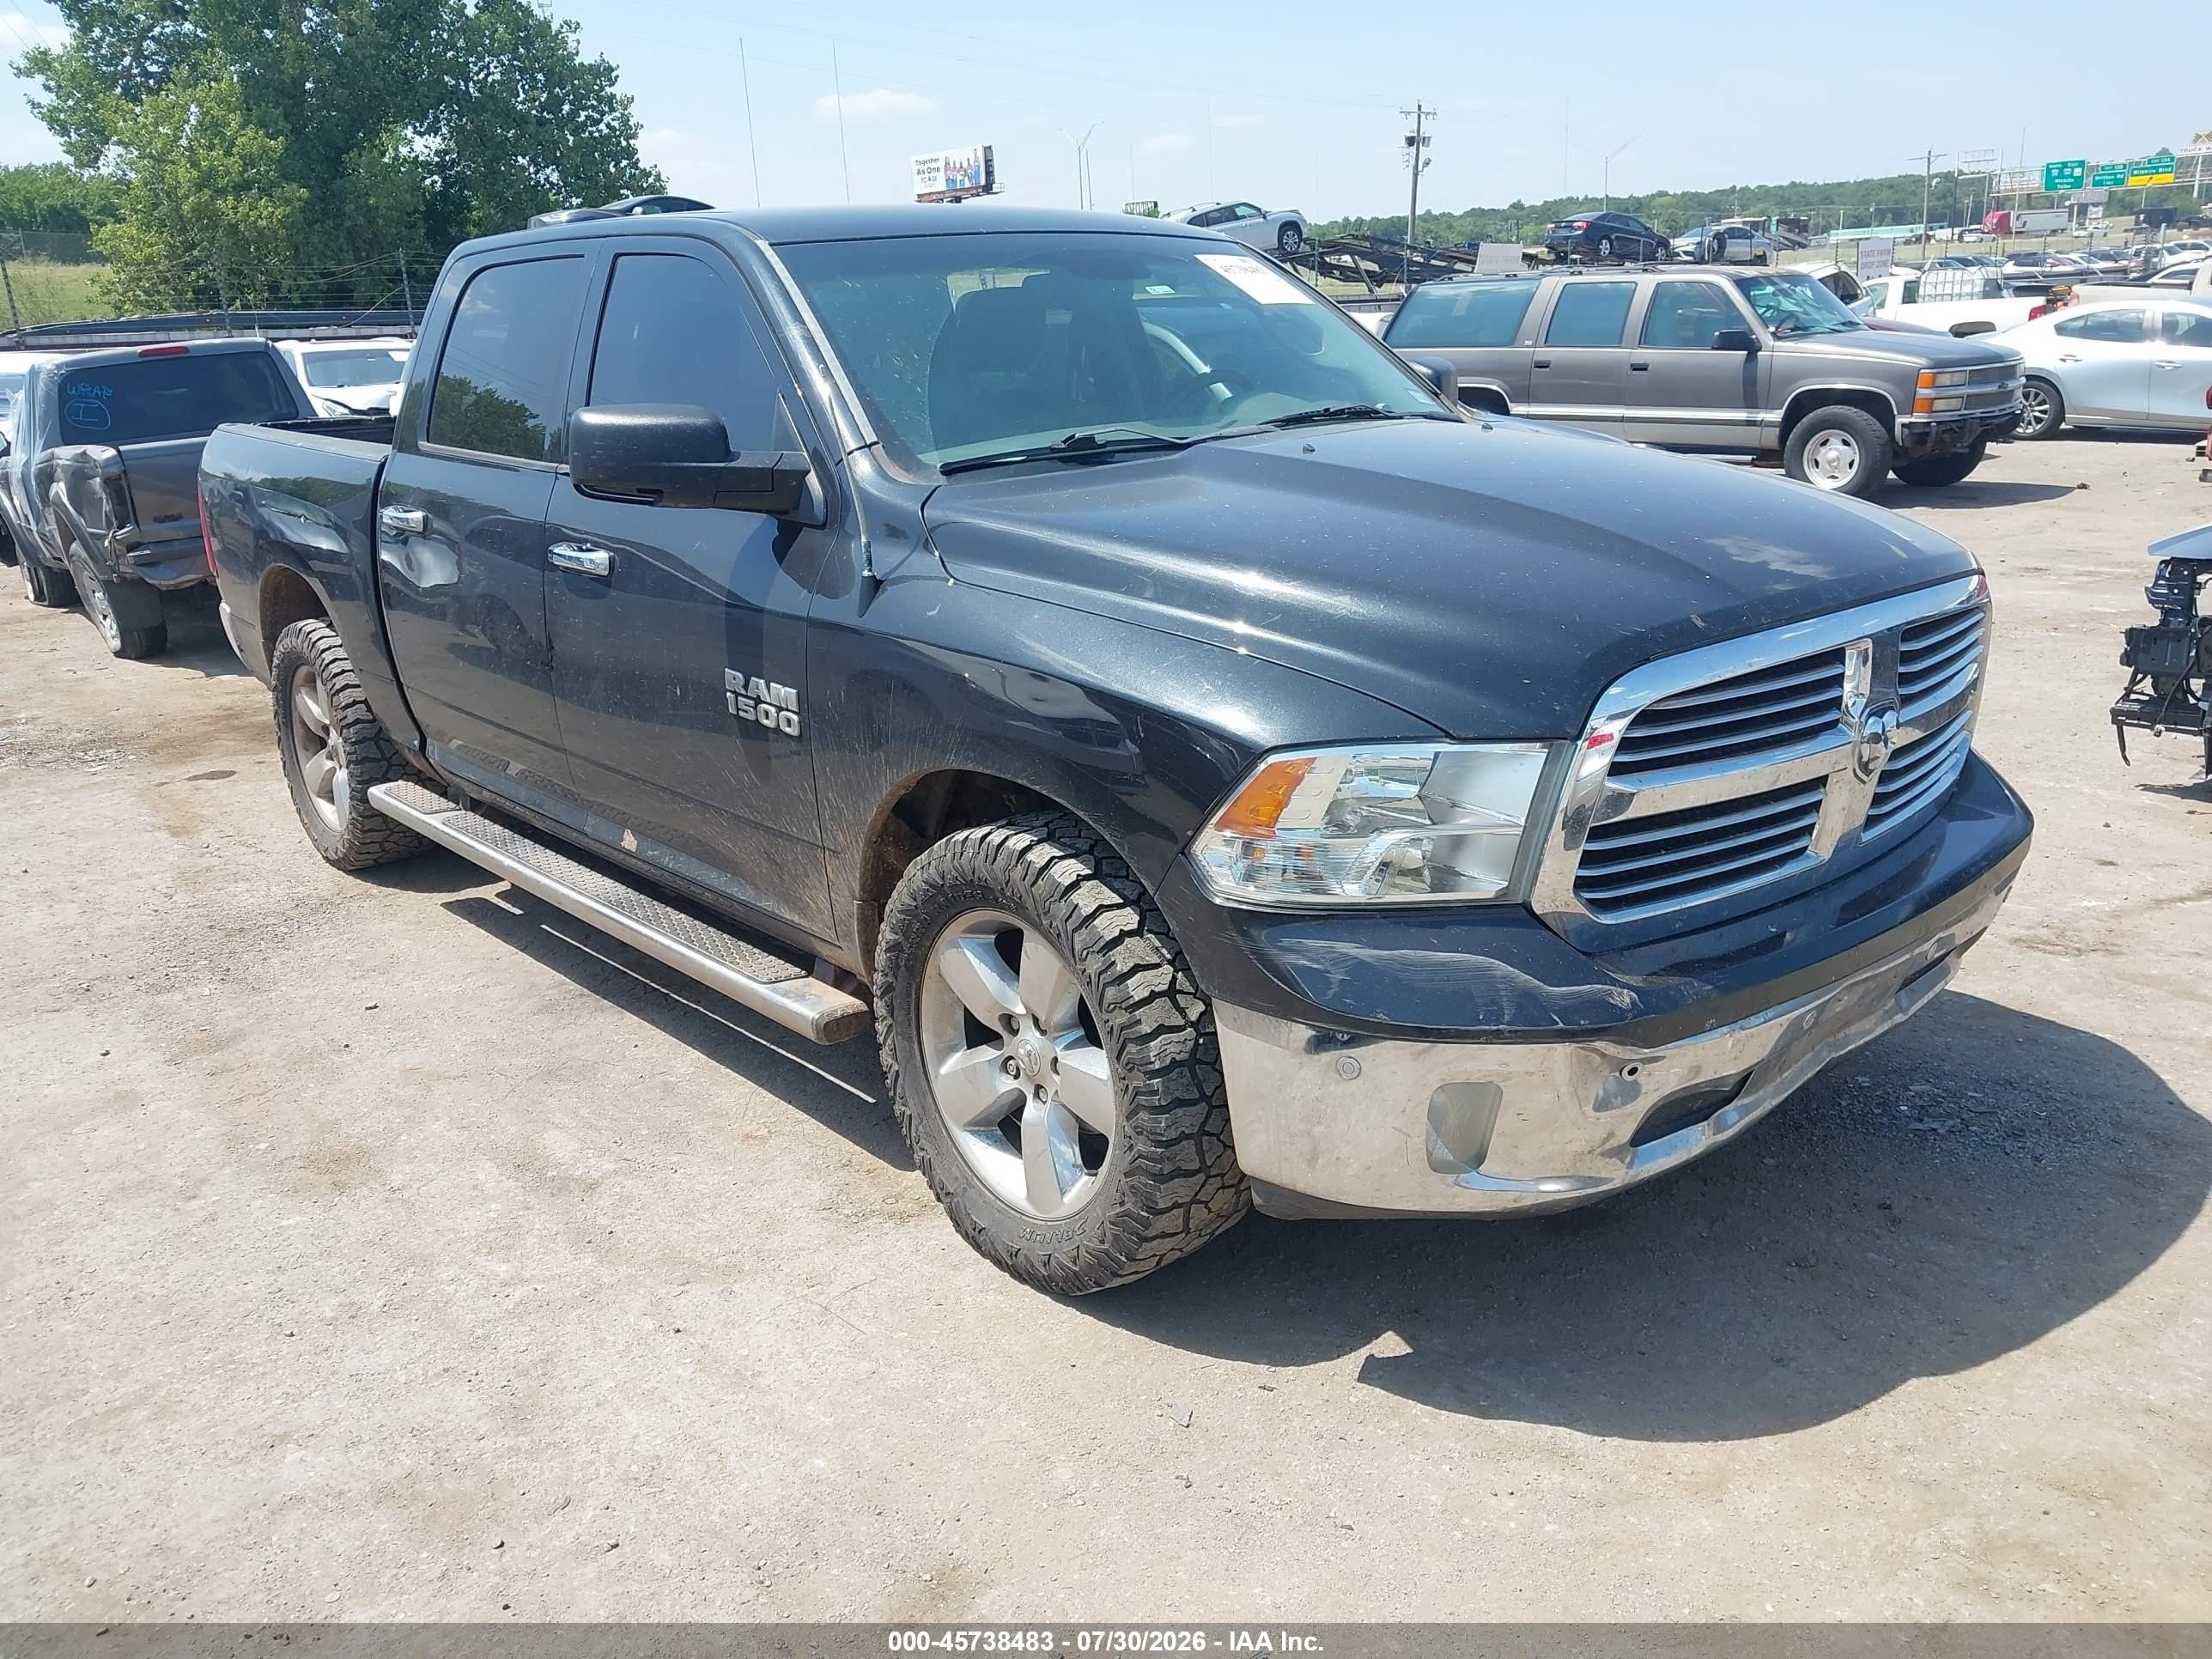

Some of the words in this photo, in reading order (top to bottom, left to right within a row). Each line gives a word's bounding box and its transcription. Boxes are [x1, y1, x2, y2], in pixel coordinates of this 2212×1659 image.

[915, 157, 940, 166] Together
[1860, 249, 1876, 258] STATE
[725, 667, 799, 713] RAM
[726, 691, 802, 737] 1500
